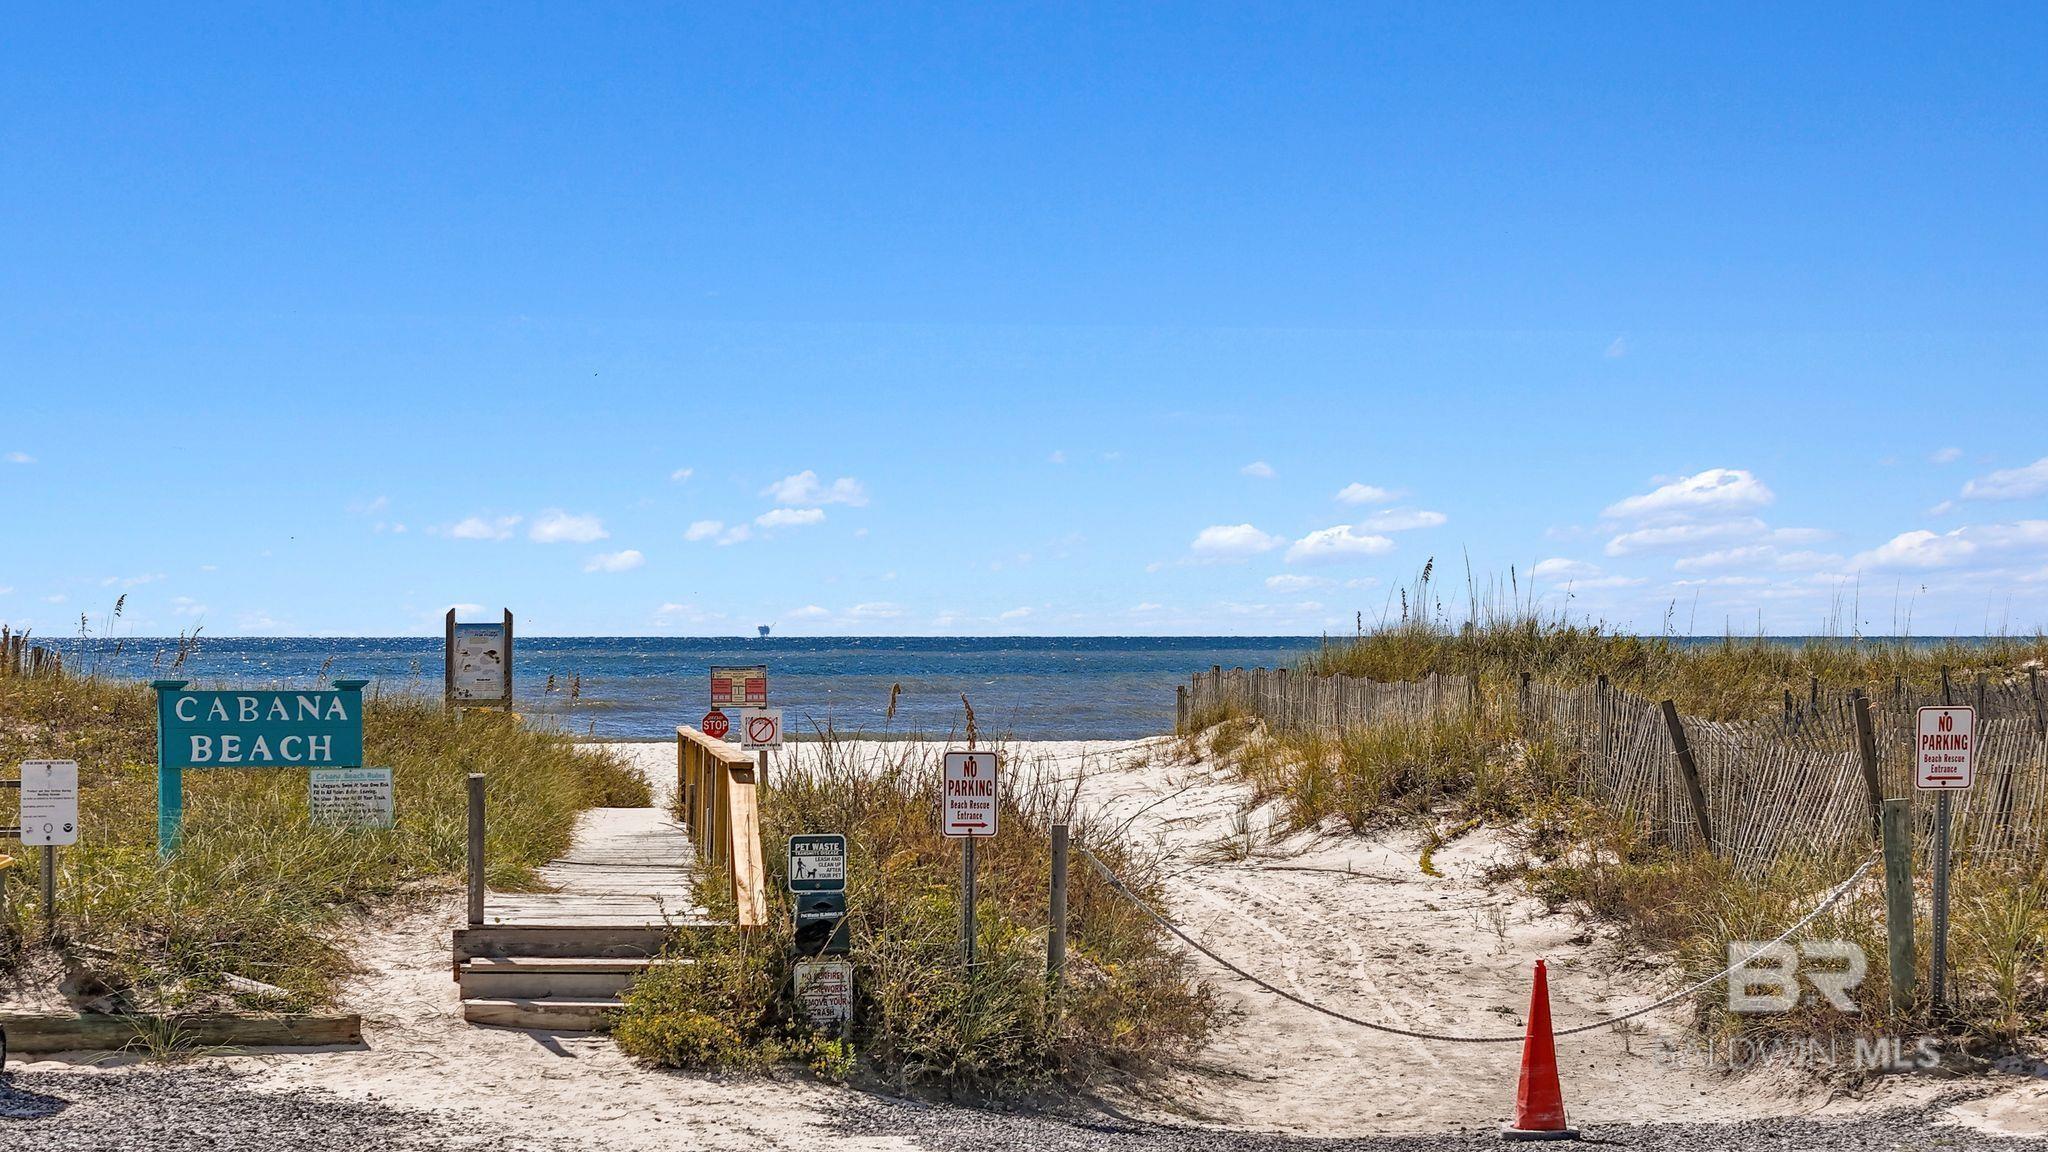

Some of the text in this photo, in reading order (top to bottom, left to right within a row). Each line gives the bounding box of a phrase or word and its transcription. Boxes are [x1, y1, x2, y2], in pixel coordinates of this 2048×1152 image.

[175, 695, 348, 722] CABANA
[703, 720, 728, 730] STOP
[1938, 715, 1953, 732] NO
[1922, 734, 1968, 750] PARKING
[189, 735, 332, 762] BEACH
[1923, 753, 1965, 763] Beach Rescue
[963, 760, 977, 778] NO
[1930, 764, 1958, 773] Entrance
[948, 780, 993, 796] PARKING
[950, 800, 990, 809] Beach Rescue
[957, 810, 983, 820] Entrance
[795, 842, 840, 851] PET WASTE
[829, 997, 847, 1006] YOUR
